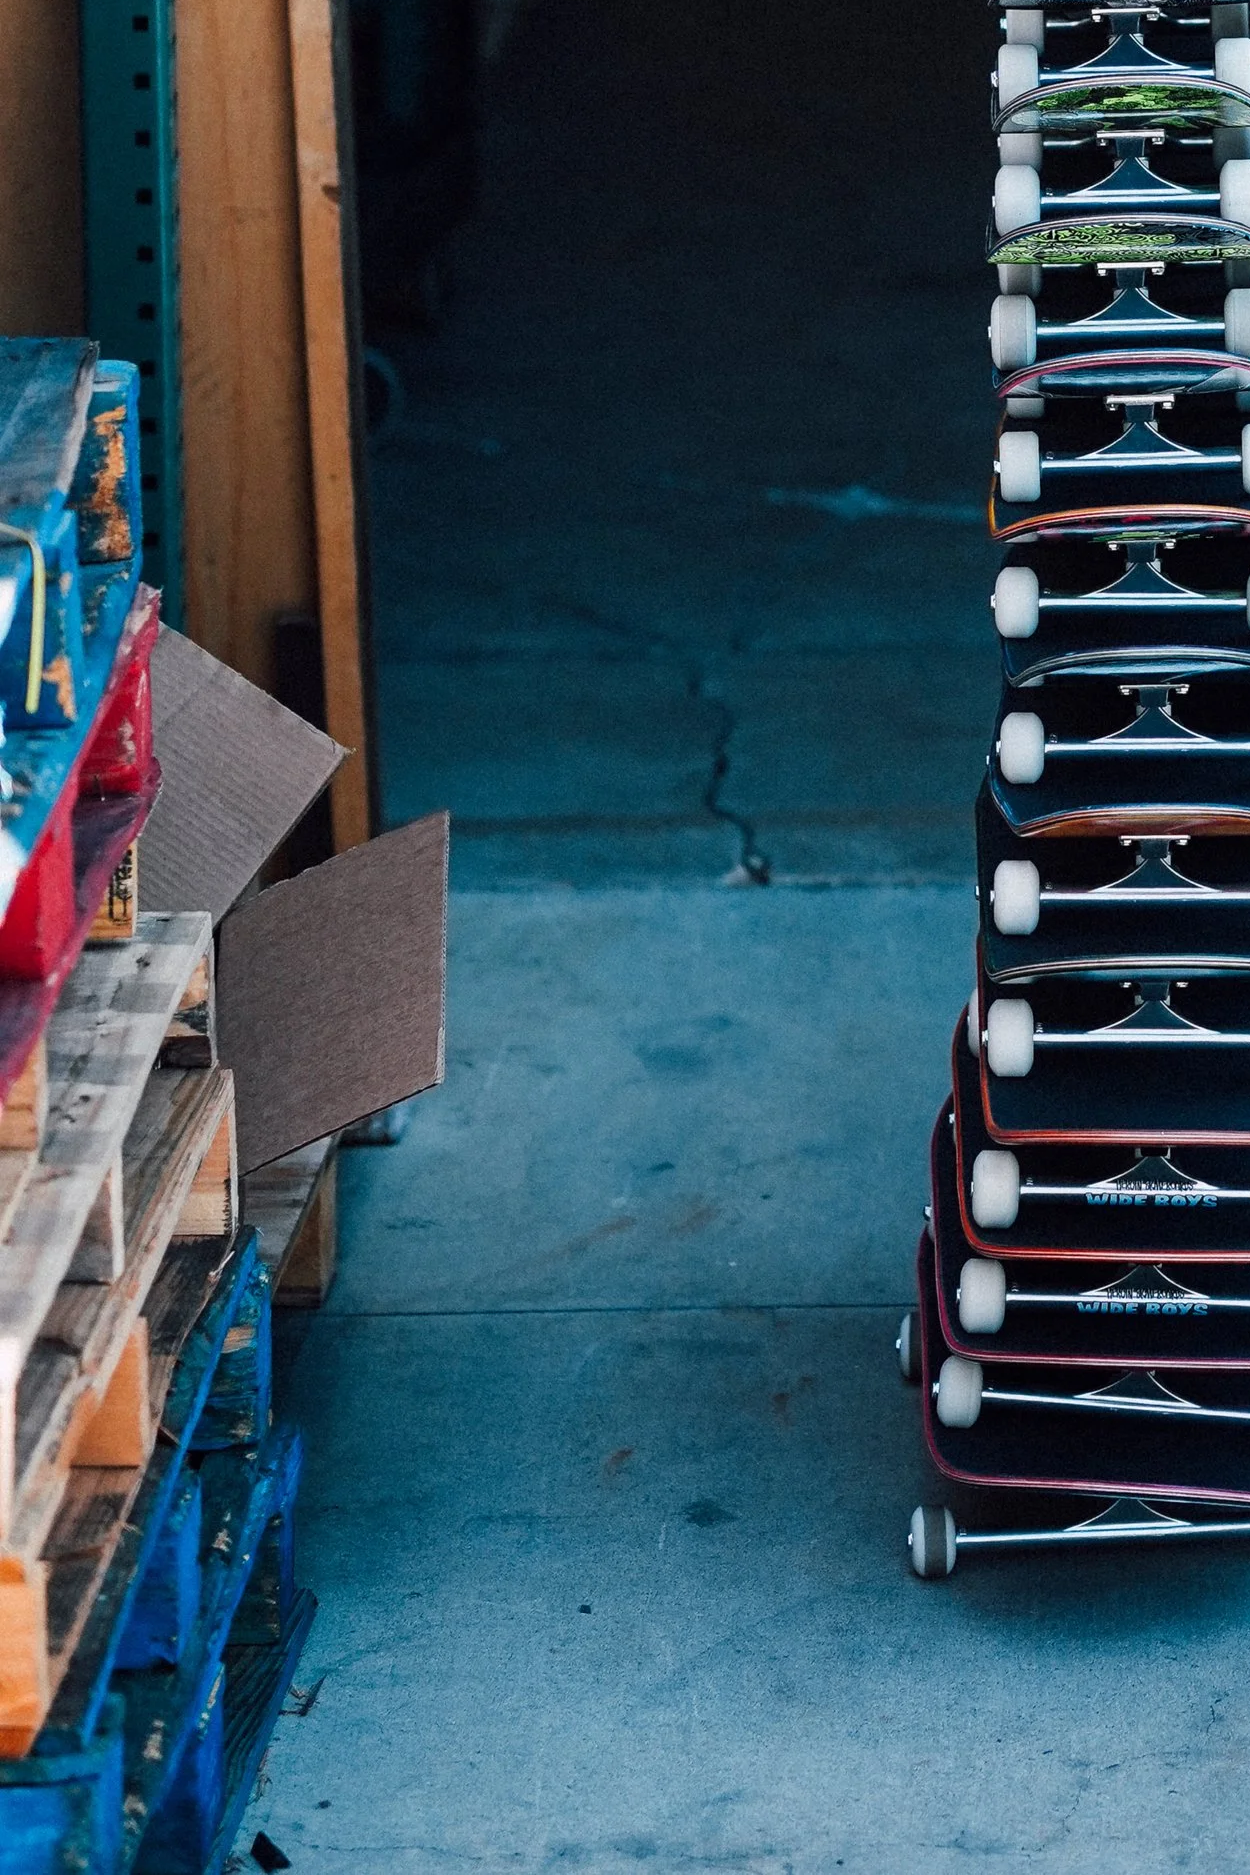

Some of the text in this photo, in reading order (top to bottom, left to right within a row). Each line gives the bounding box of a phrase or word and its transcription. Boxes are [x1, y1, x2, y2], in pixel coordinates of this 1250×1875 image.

[1085, 1192, 1218, 1207] WIDE BOYS
[1076, 1301, 1209, 1316] WIDE BOYS
